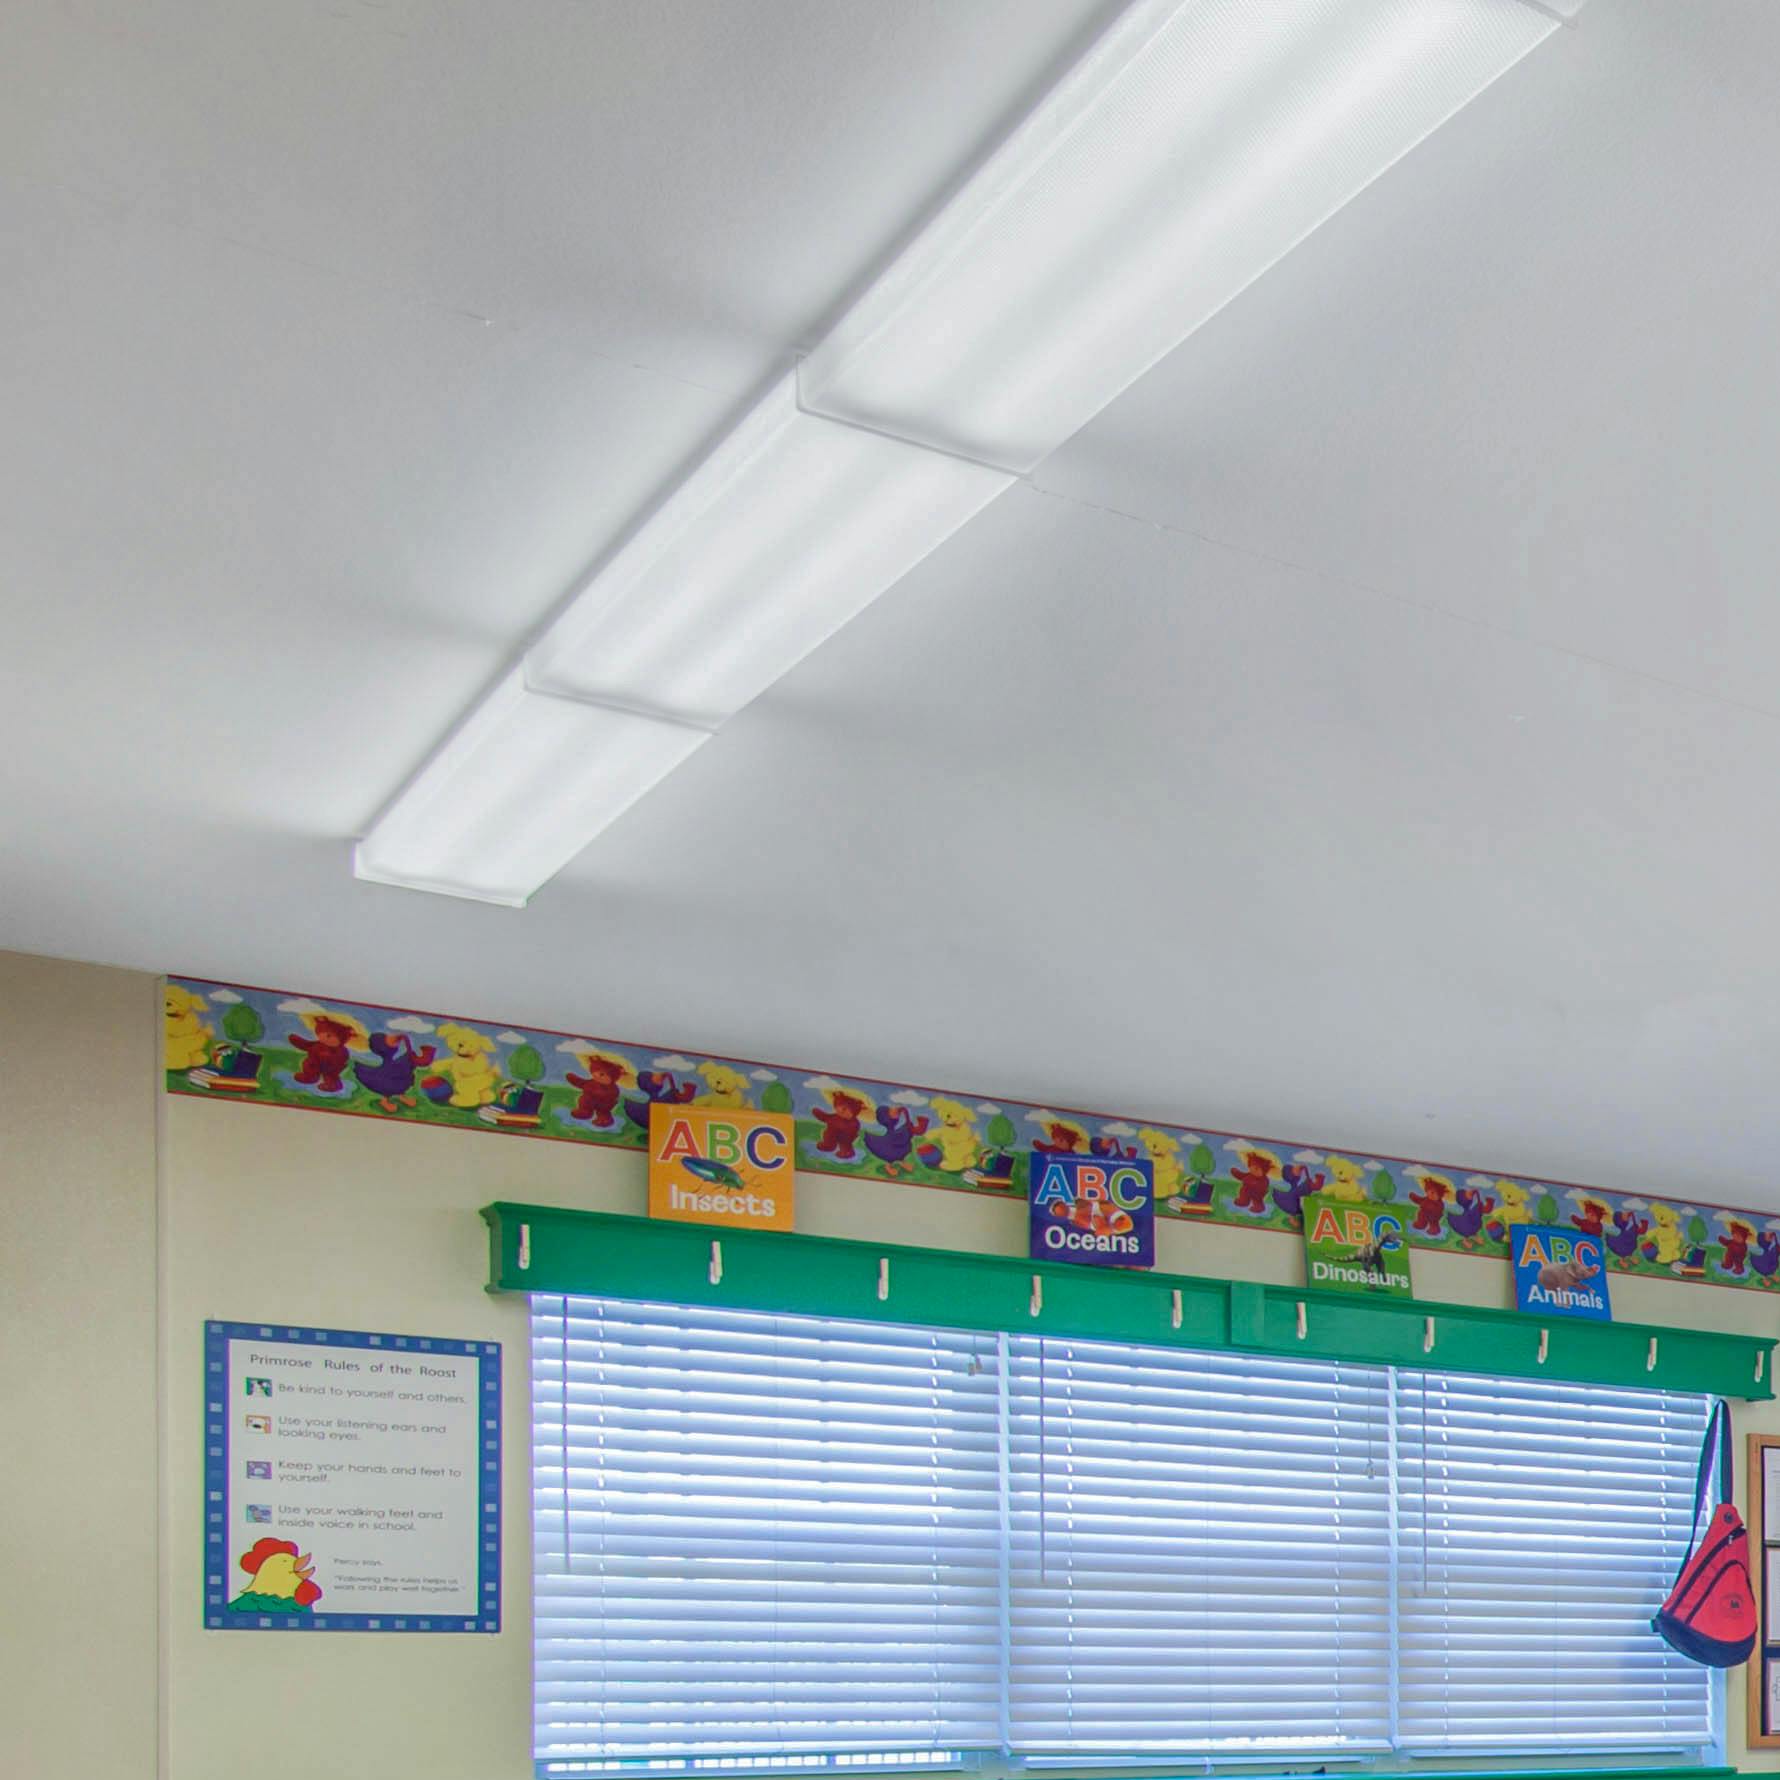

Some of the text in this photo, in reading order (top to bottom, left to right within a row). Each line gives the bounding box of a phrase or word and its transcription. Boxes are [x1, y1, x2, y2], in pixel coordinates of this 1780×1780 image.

[656, 1119, 787, 1171] ABC
[671, 1184, 775, 1216] Insects
[1034, 1164, 1147, 1210] ABC
[1045, 1226, 1140, 1253] Oceans
[1311, 1208, 1402, 1251] ABC
[1519, 1234, 1600, 1272] ABC
[1312, 1262, 1409, 1288] Dinosaurs
[1528, 1285, 1604, 1309] Animals
[250, 1353, 457, 1379] Primrose Rules of the Roost
[279, 1383, 467, 1404] Be kind to yourself and others.
[278, 1429, 325, 1441] looking
[279, 1416, 446, 1434] Use your listening ears and
[278, 1460, 462, 1478] Keep your hands and feet to
[278, 1504, 443, 1520] Use your walking feet and
[278, 1518, 417, 1531] inside voice in school.
